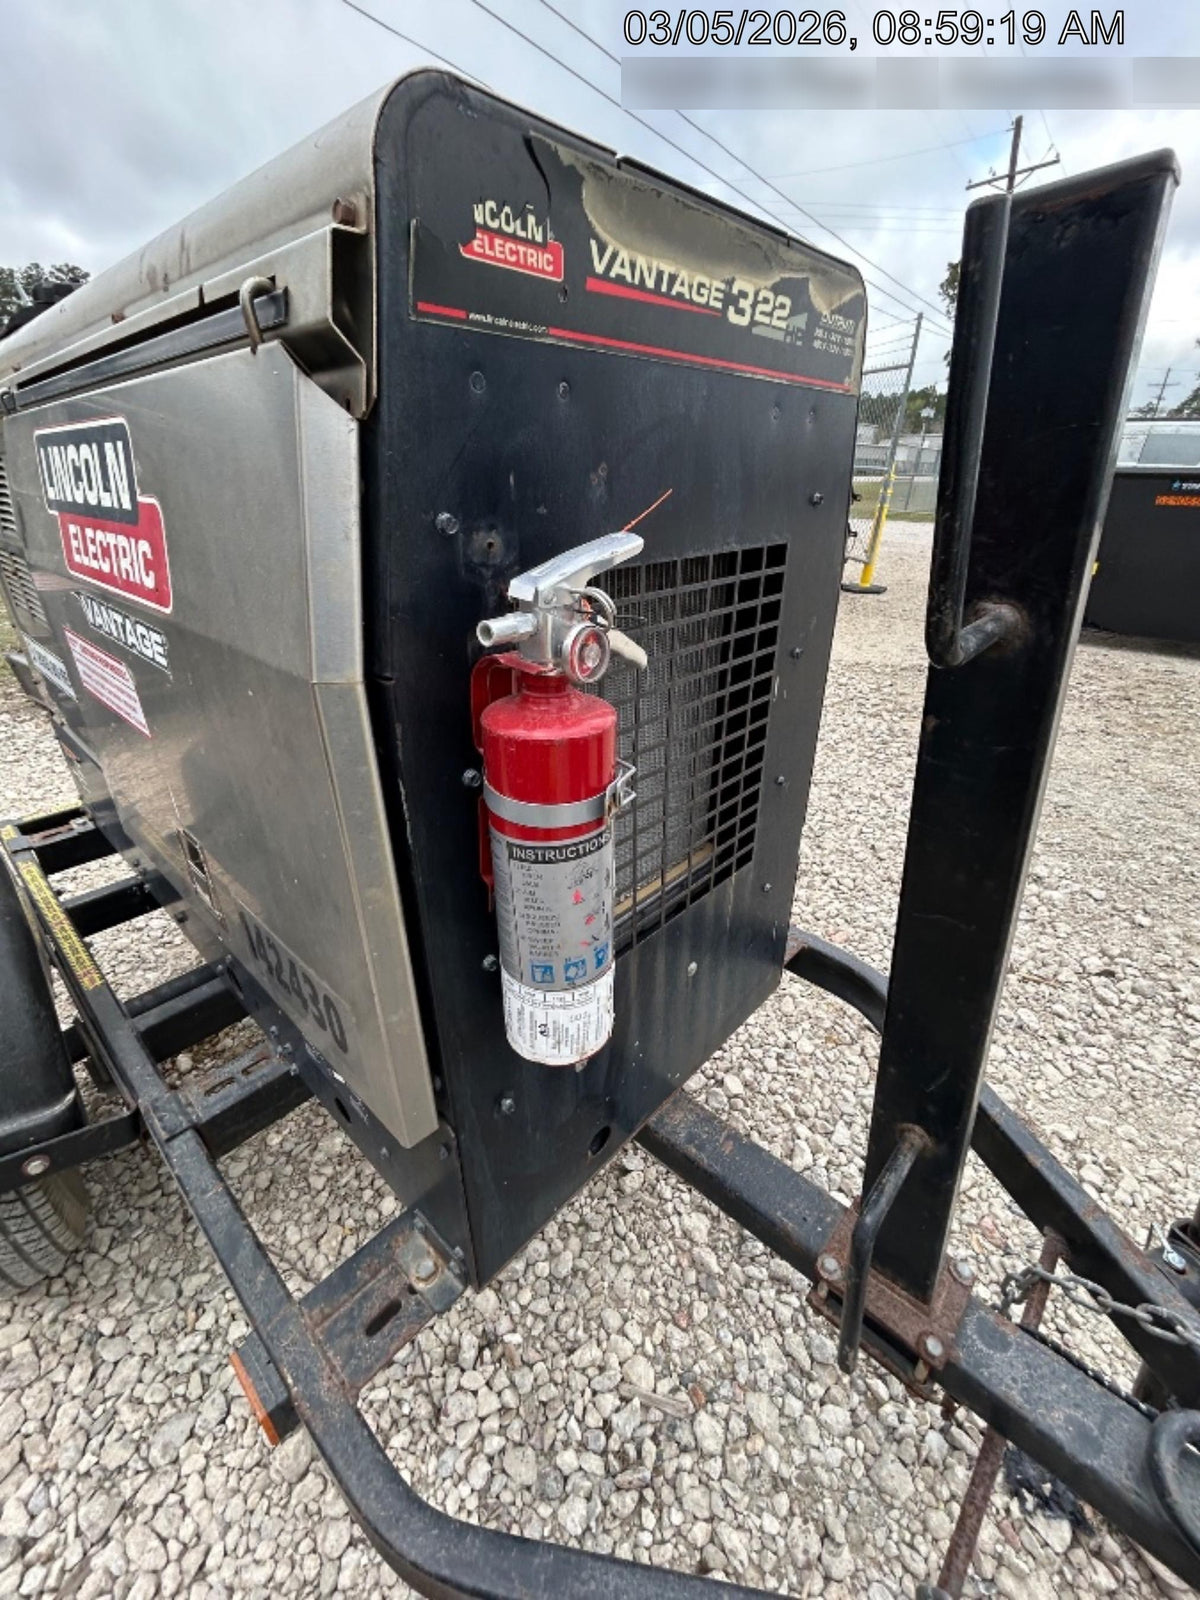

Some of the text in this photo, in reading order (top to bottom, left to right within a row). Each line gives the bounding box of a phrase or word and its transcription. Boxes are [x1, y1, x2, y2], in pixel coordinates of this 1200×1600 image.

[472, 231, 554, 273] ELECTRIC
[590, 238, 792, 330] VANTAGE 322
[40, 440, 132, 512] LINCOLN
[68, 524, 156, 590] ELECTRIC
[80, 596, 169, 669] VANTAGE
